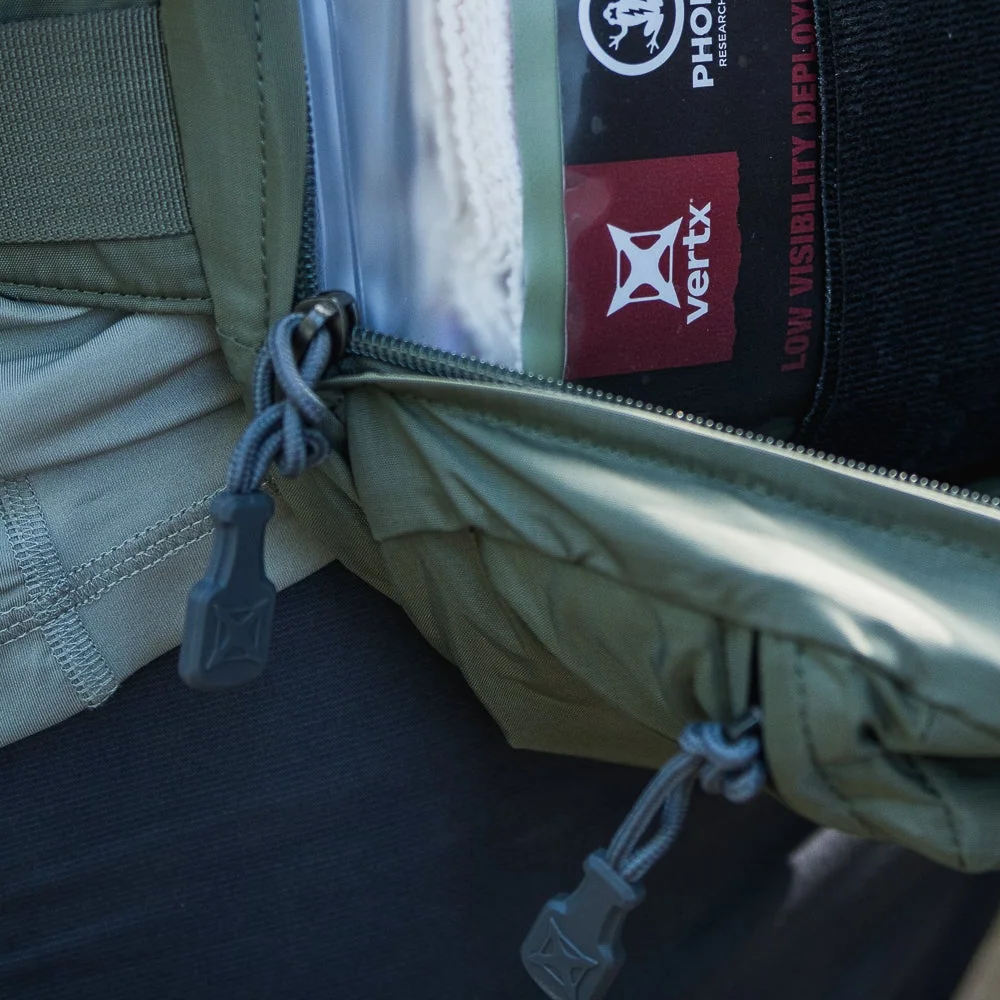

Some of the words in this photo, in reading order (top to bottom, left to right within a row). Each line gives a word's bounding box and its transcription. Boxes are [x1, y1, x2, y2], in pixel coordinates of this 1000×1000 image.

[683, 200, 711, 325] vertx
[789, 136, 816, 297] VISIBILITY
[781, 307, 813, 372] LOW
